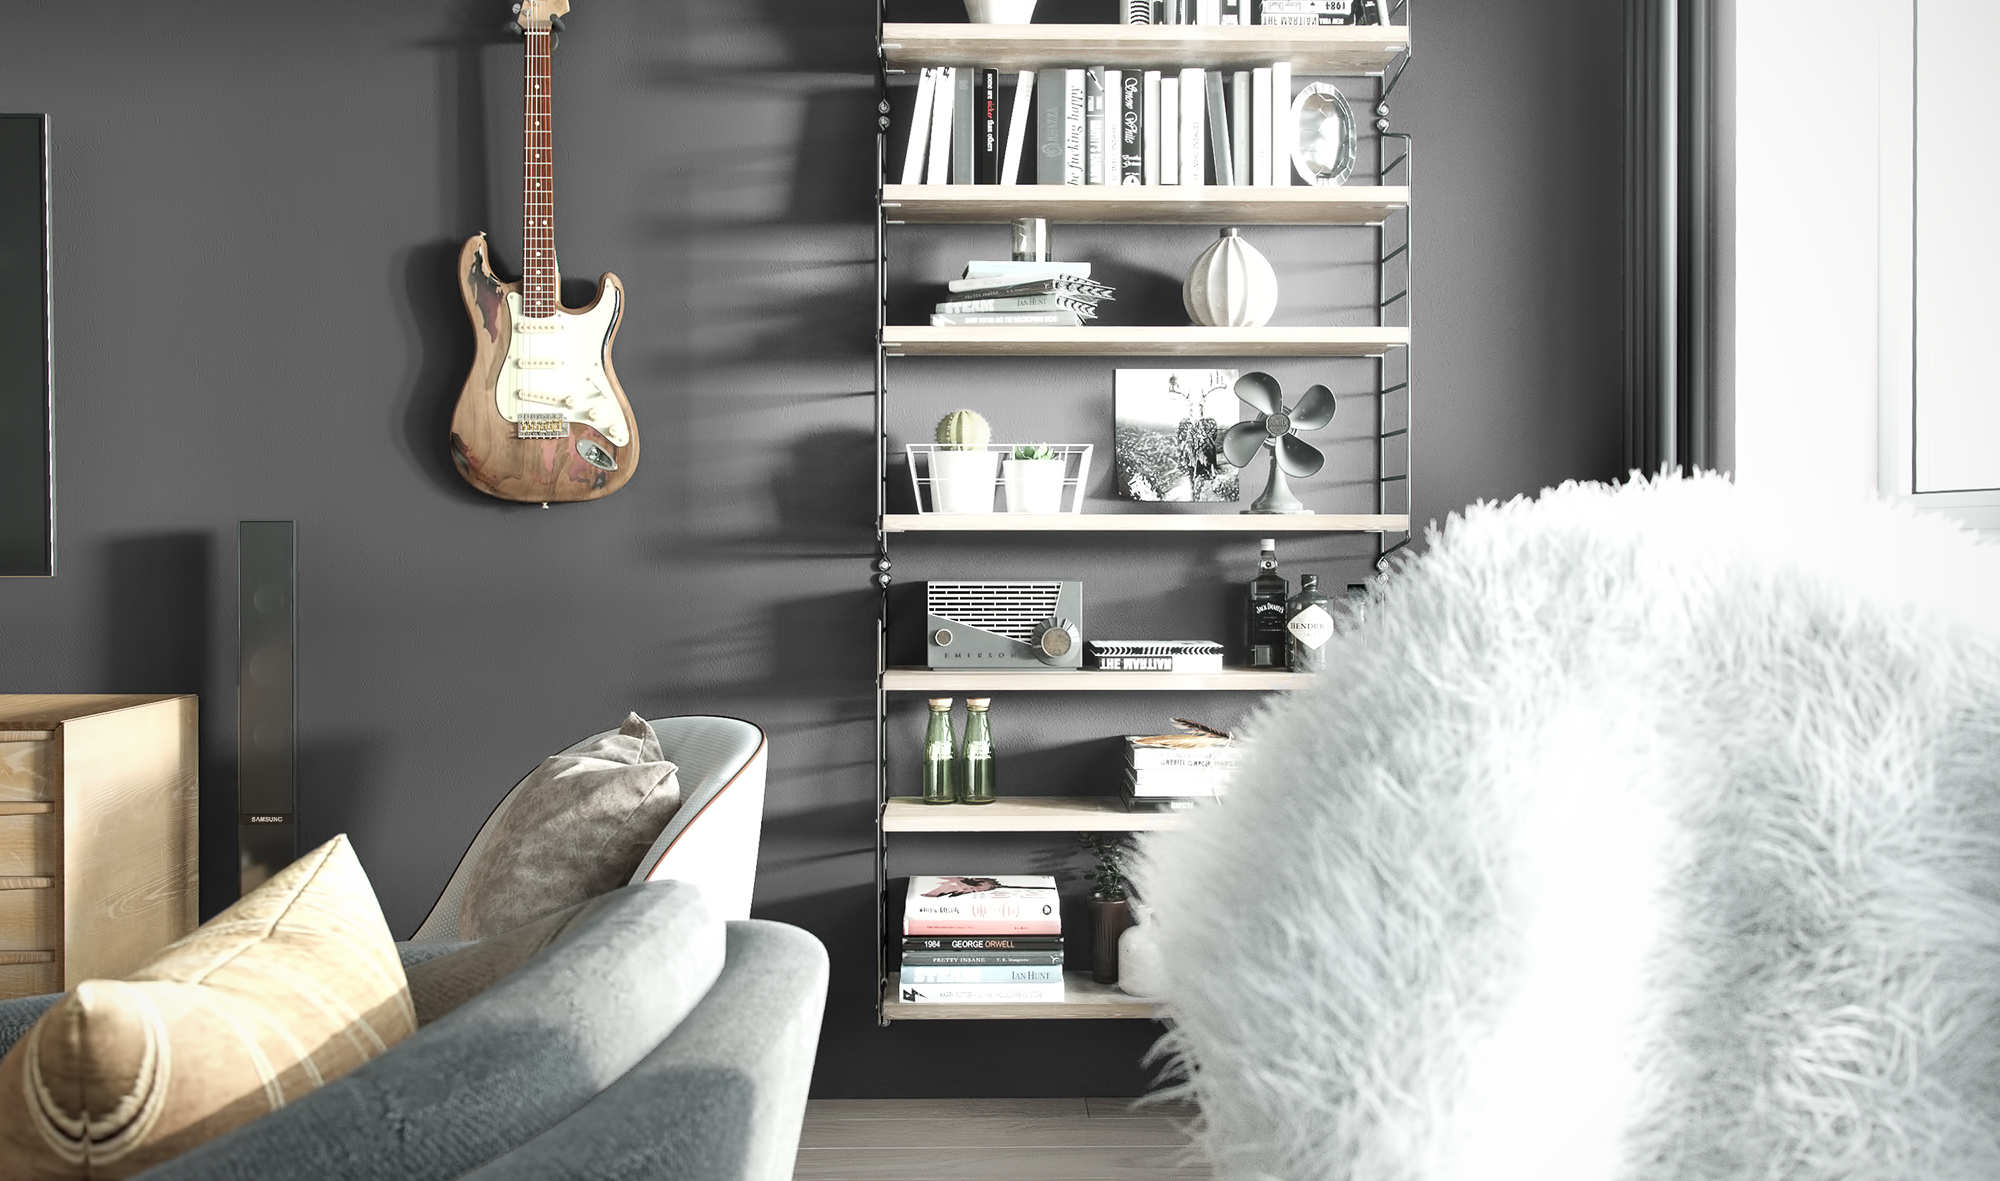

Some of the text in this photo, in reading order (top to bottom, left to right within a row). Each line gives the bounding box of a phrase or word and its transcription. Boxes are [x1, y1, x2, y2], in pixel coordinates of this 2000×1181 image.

[1325, 1, 1346, 10] 1984
[1125, 111, 1138, 144] White
[1067, 85, 1083, 186] be fucking happy
[987, 133, 995, 152] others
[945, 299, 994, 314] STEAM
[1029, 298, 1046, 306] HUNT
[1256, 604, 1268, 614] JACK
[1160, 758, 1186, 766] GABRIEL
[924, 940, 1015, 948] 1984 GEORGE ORWELL
[1012, 971, 1026, 980] IAN
[1027, 970, 1050, 980] HUNT
